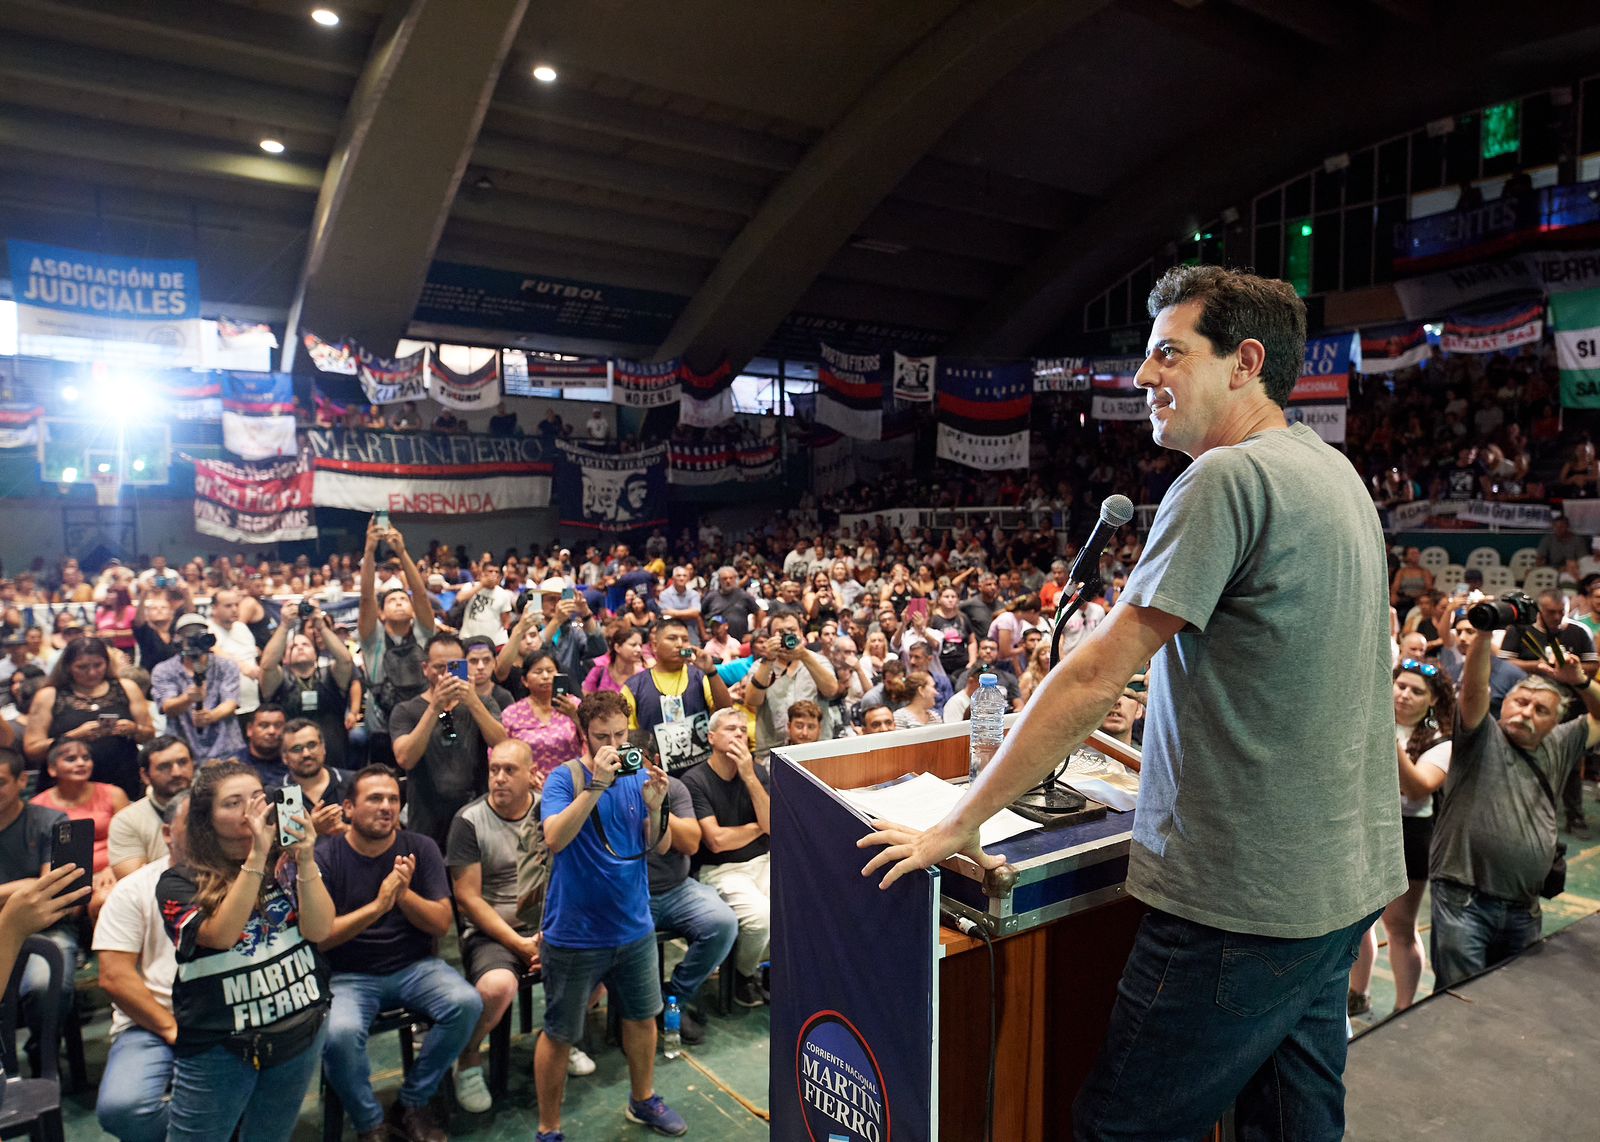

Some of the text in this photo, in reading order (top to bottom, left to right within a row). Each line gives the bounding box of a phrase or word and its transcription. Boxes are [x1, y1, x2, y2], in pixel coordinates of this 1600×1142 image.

[31, 257, 185, 290] ASOCIACIÓN DE
[520, 279, 604, 301] FUTBOL
[23, 276, 187, 315] JUDICIALES
[1576, 340, 1596, 358] SI
[1576, 381, 1600, 396] SA
[308, 430, 447, 464] MARTIN
[388, 493, 497, 515] ENSENADA
[222, 944, 316, 1006] MARTIN
[232, 974, 321, 1033] FIERRO
[806, 1041, 878, 1095] CORRIENTE NACIONAL
[802, 1052, 882, 1124] MARTÍN
[804, 1078, 881, 1142] FIERRO
